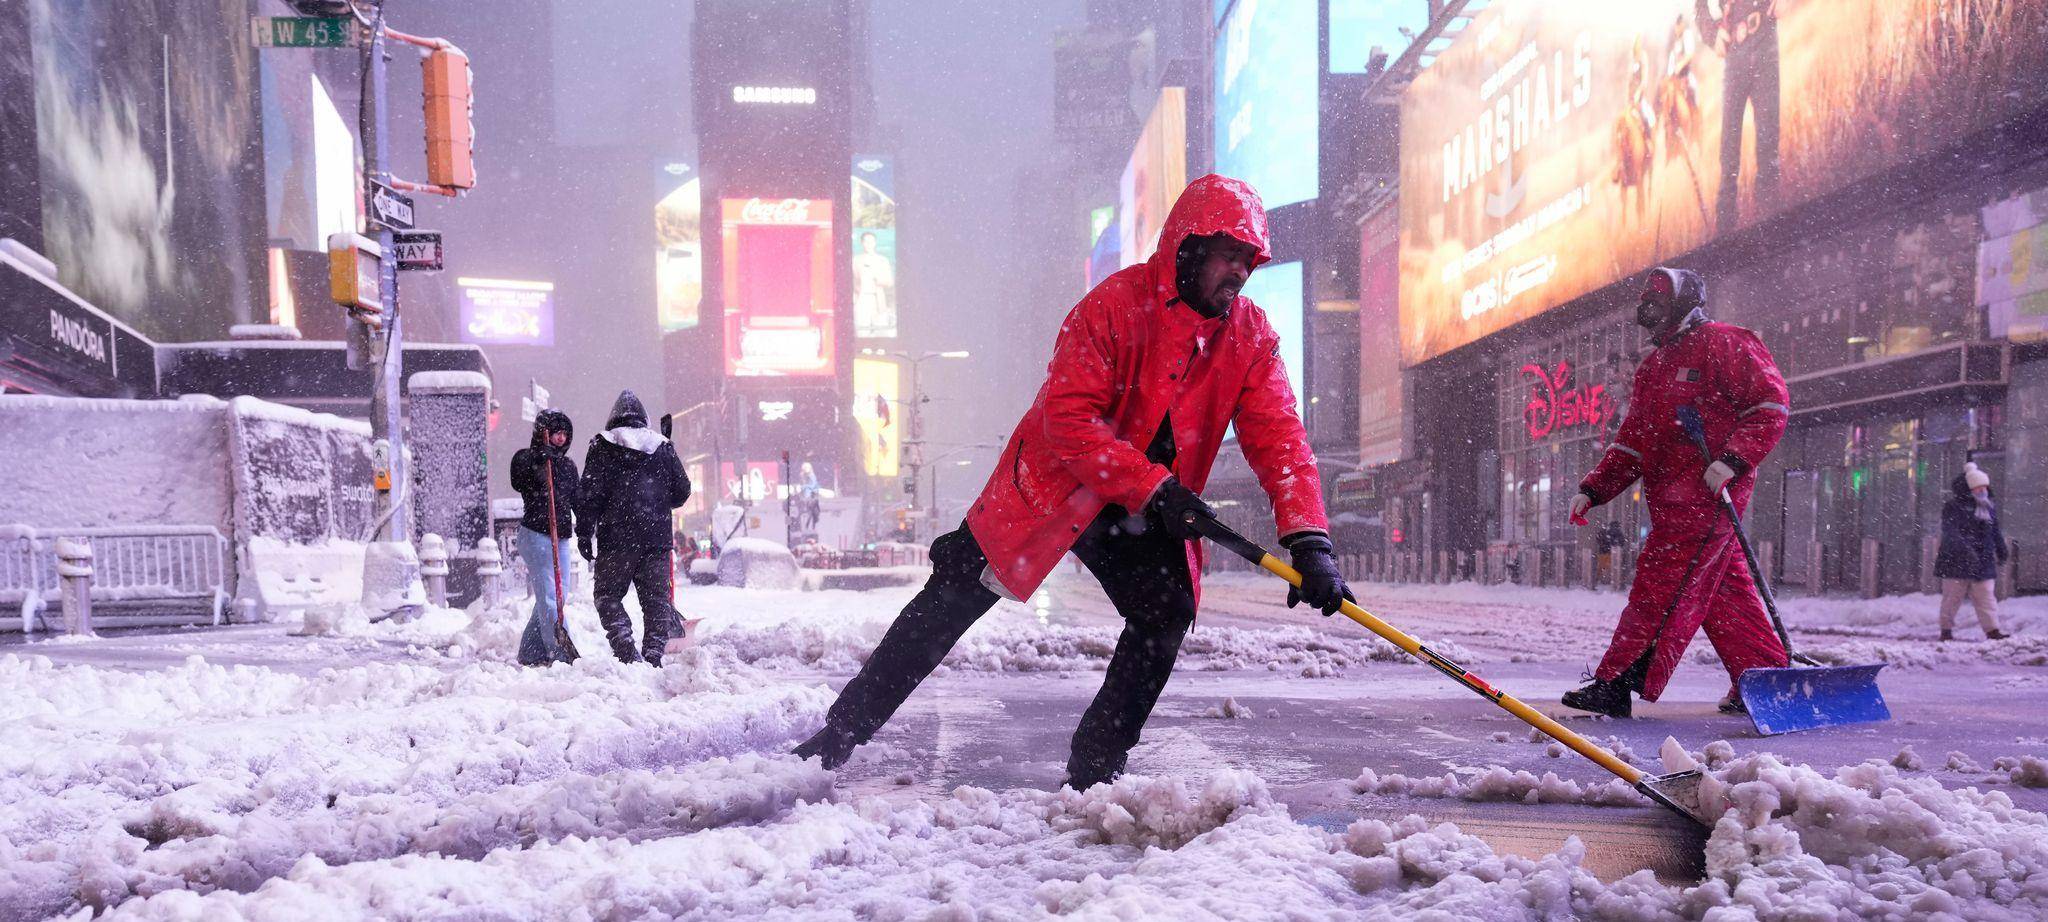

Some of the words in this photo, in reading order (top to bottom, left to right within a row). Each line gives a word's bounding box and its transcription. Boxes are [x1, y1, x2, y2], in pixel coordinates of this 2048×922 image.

[276, 21, 294, 44] W
[305, 21, 329, 45] 45
[733, 86, 816, 104] SAMSUNG
[1443, 31, 1592, 203] MARSHALS
[379, 195, 393, 215] ONE
[397, 203, 411, 219] WAY
[394, 245, 426, 259] WAY
[51, 309, 106, 363] PANDORA
